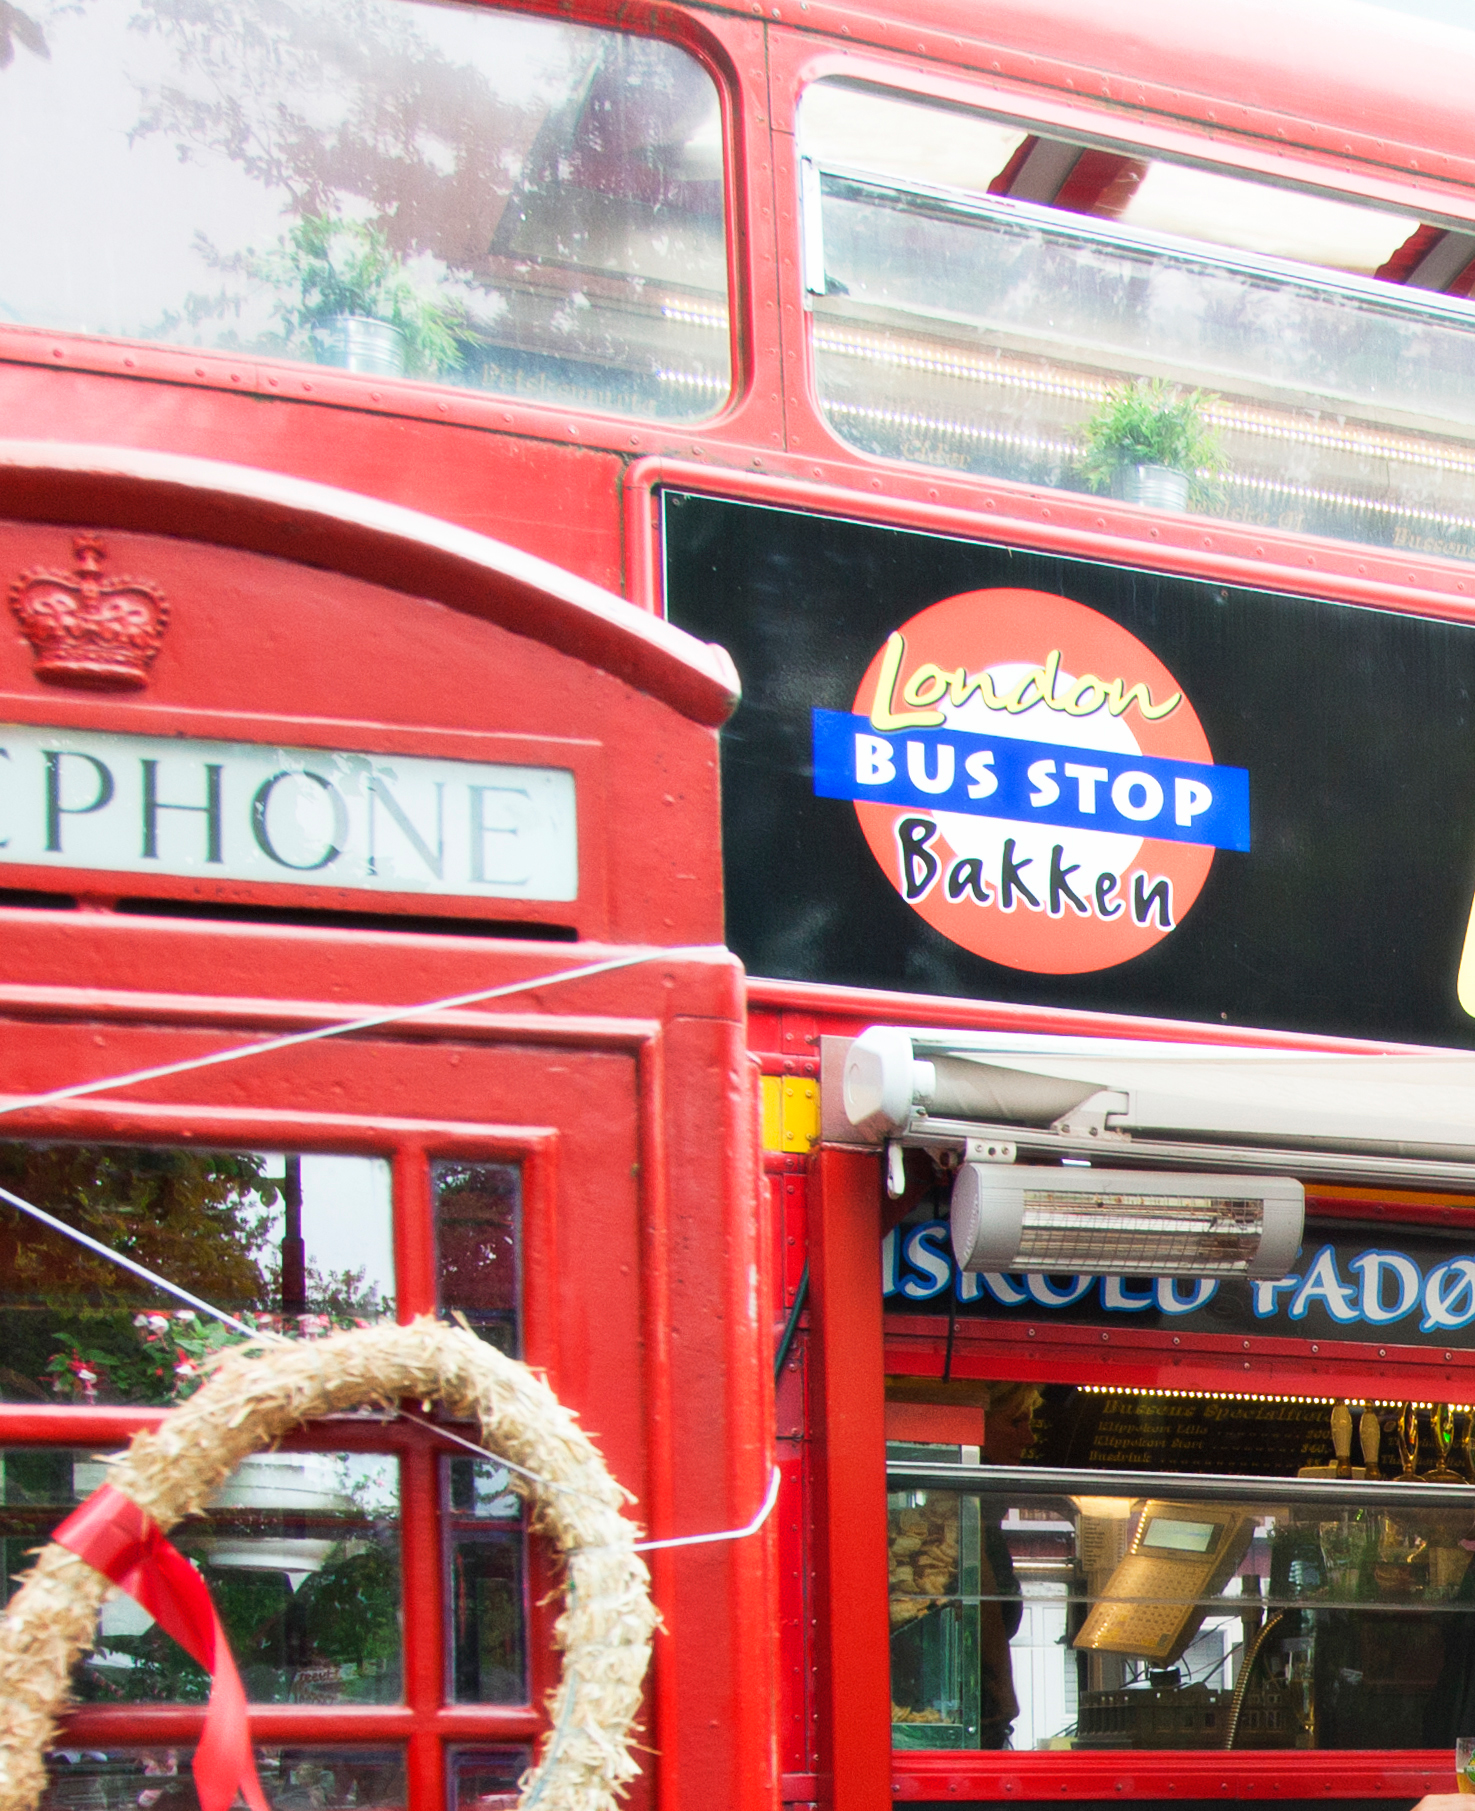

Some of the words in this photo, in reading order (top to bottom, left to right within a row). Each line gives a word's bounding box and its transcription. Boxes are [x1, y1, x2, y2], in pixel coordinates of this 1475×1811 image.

[870, 631, 1182, 731] London
[0, 746, 533, 887] PHONE
[854, 733, 998, 800] BUS
[1027, 759, 1213, 828] STOP
[897, 815, 1175, 931] Bakken
